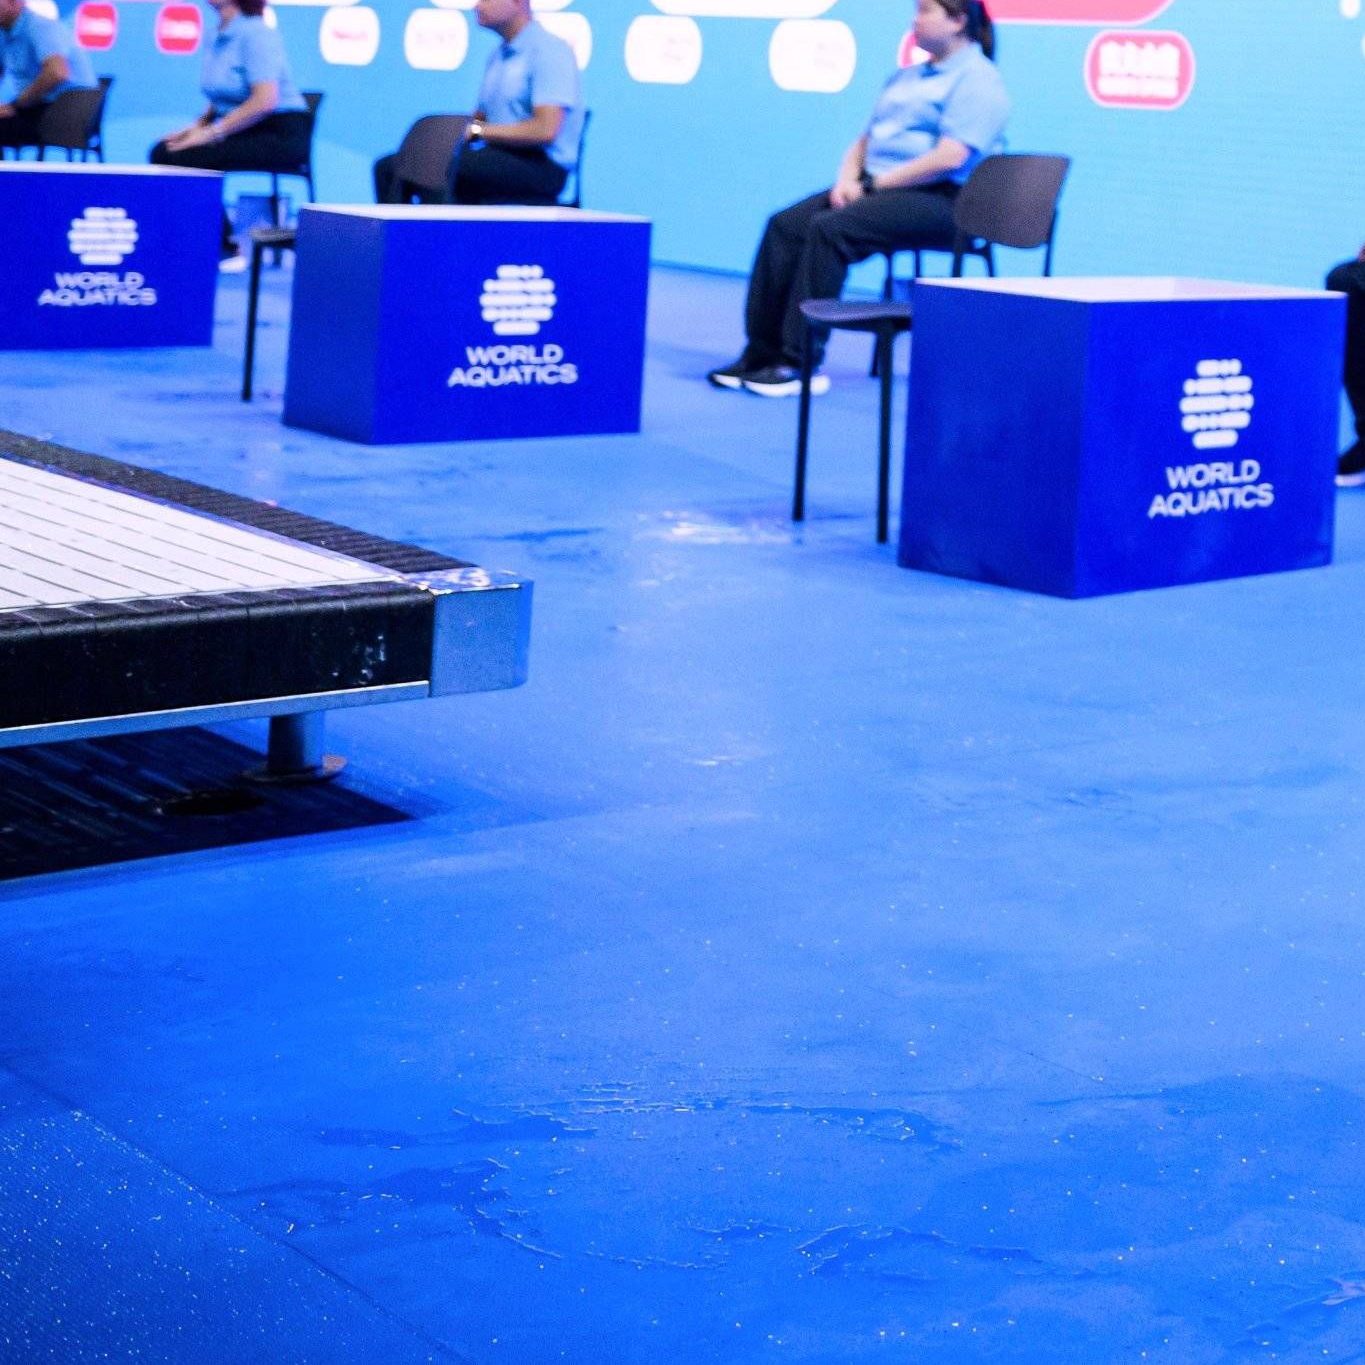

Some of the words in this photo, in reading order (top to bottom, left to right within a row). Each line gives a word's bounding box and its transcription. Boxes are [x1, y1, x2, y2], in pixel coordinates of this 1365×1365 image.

[54, 271, 145, 291] WORLD
[37, 287, 158, 307] AQUATICS
[465, 343, 564, 366] WORLD
[447, 362, 579, 388] AQUATICS
[1165, 459, 1261, 490] WORLD
[1147, 483, 1275, 519] AQUATICS
